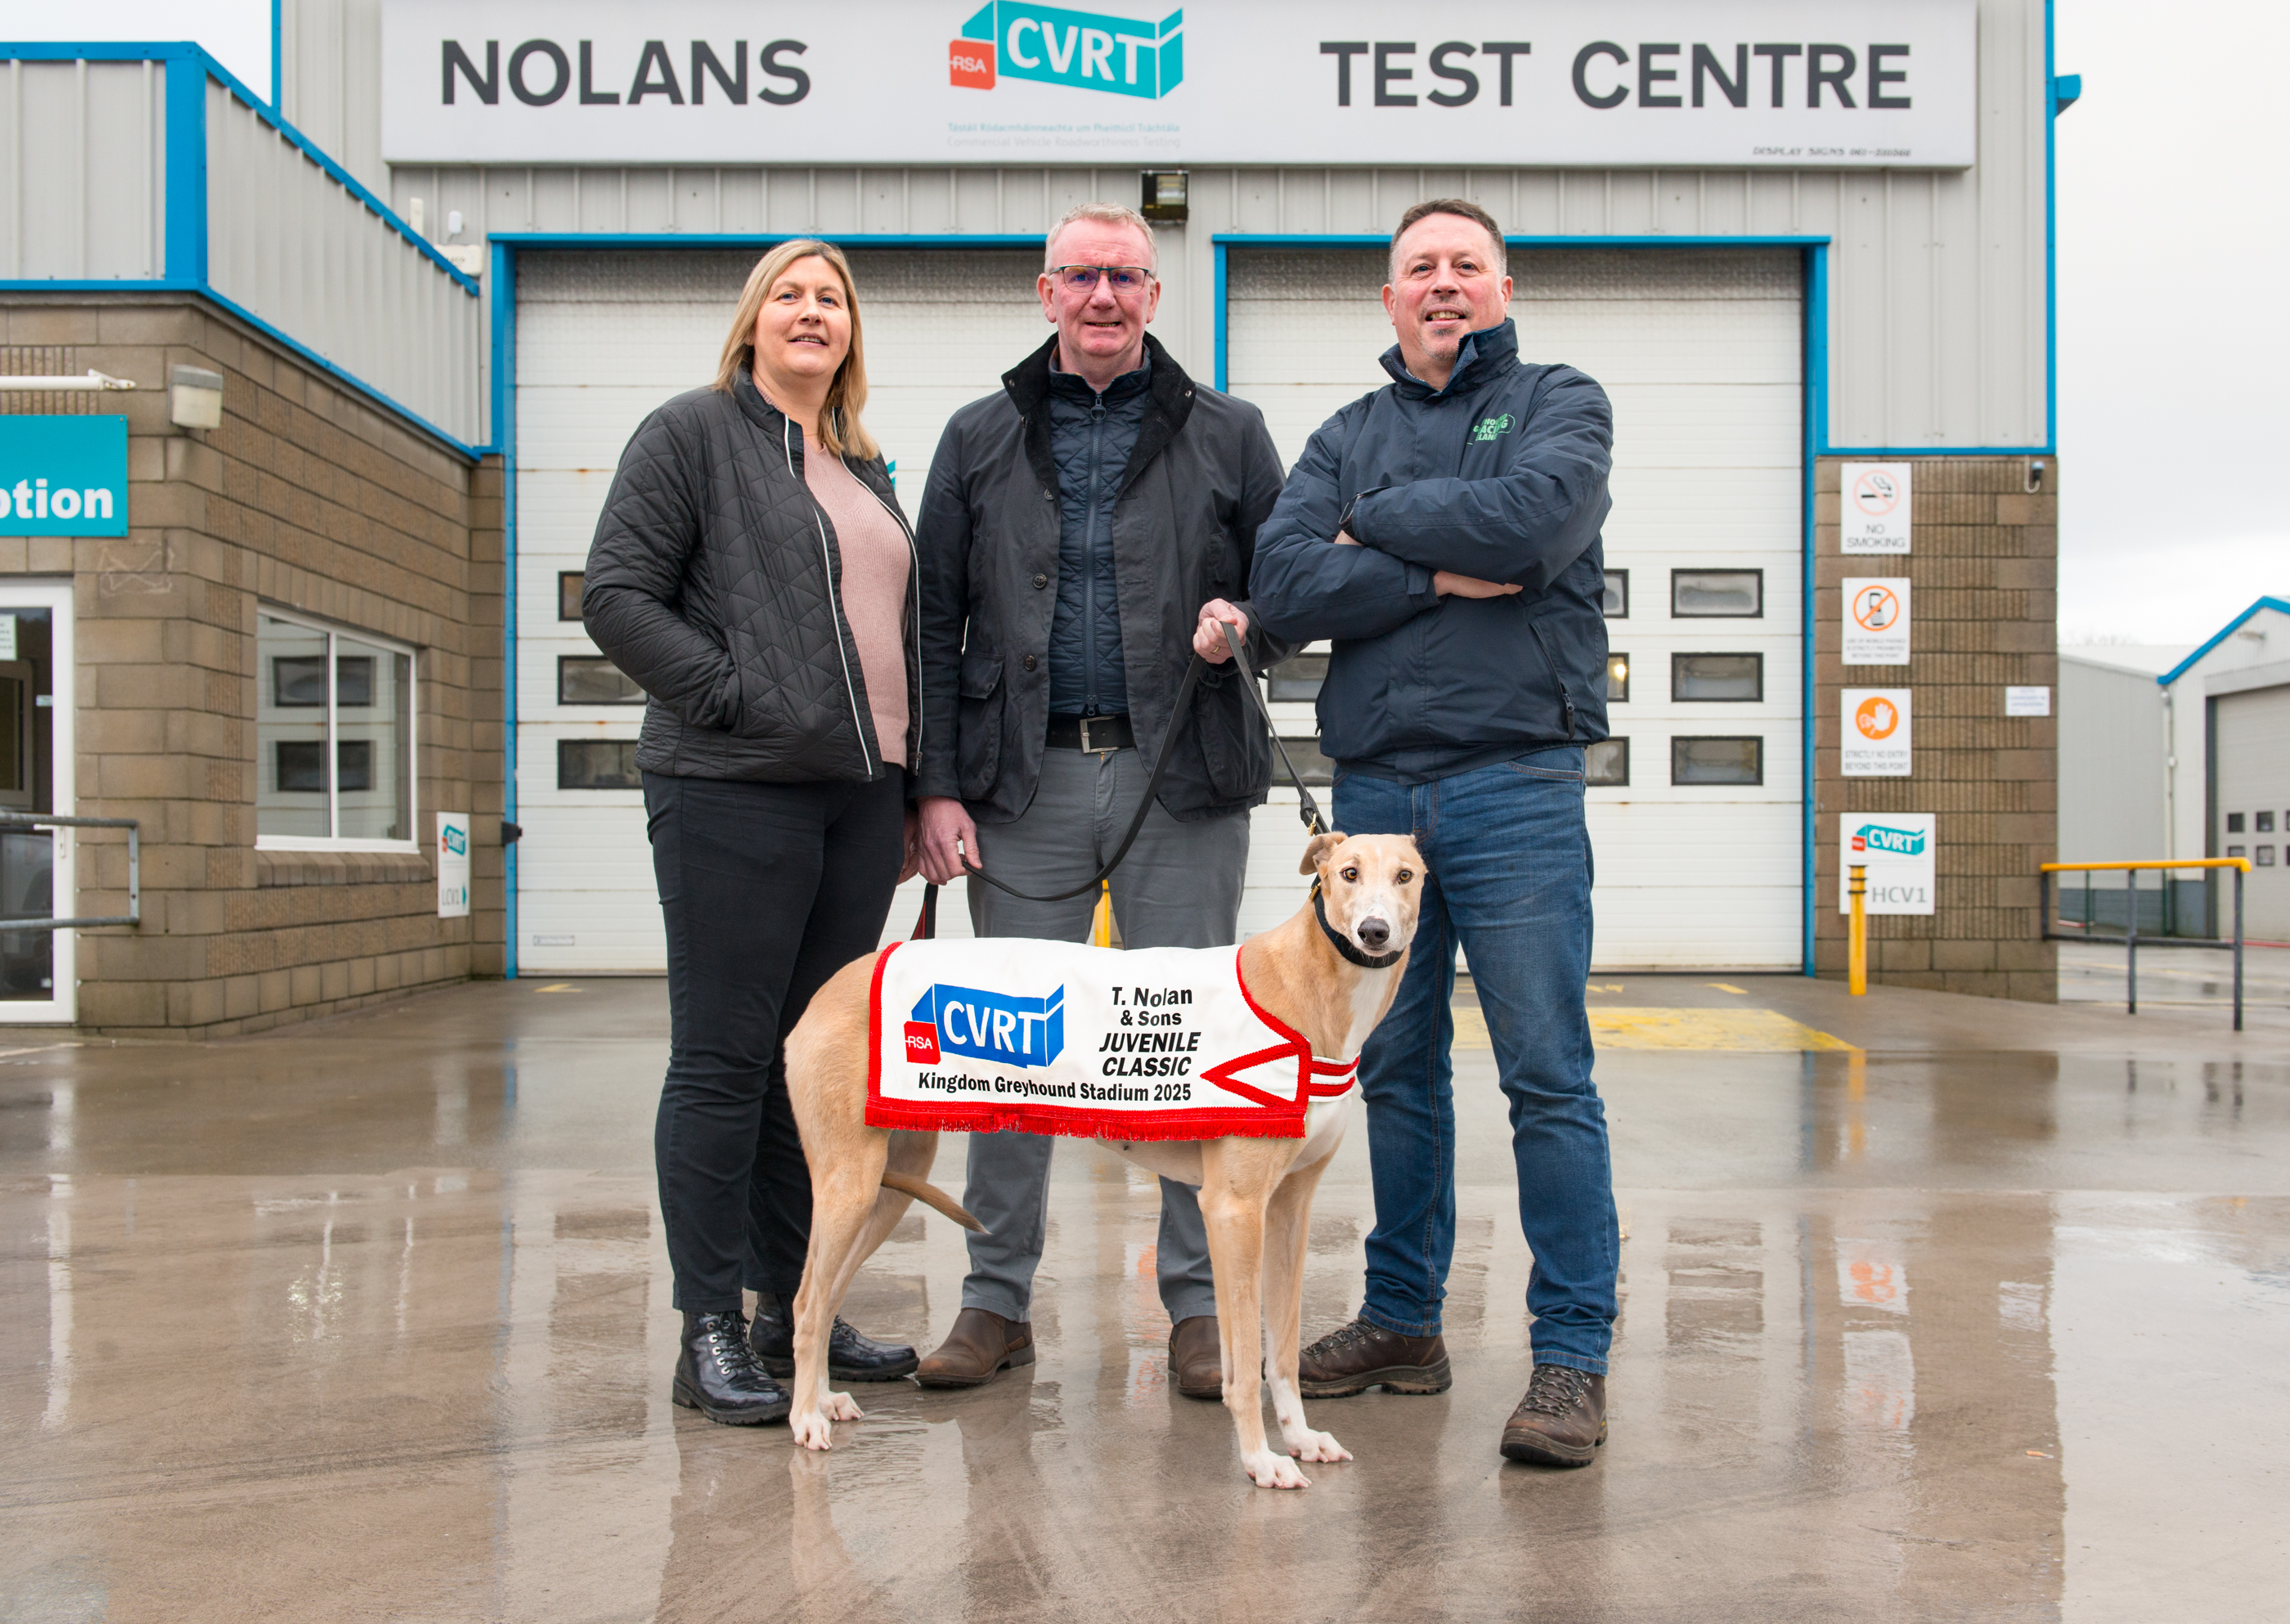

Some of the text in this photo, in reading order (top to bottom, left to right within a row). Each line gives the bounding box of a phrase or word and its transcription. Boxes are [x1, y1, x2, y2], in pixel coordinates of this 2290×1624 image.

[1007, 17, 1155, 85] CVRT
[442, 38, 810, 106] NOLANS
[951, 55, 987, 74] RSA
[1319, 41, 1912, 109] TEST CENTRE
[947, 137, 1181, 149] Commercial Vehicle Roadworthiness Testing
[1866, 523, 1885, 534] NO
[1847, 536, 1906, 548] SMOKING
[1869, 828, 1914, 852] CVRT
[1872, 886, 1927, 903] HCV1
[1112, 986, 1192, 1007] T. Nolan
[943, 1000, 1044, 1054] CVRT
[1120, 1009, 1182, 1026] & Sons
[906, 1035, 933, 1050] RSA
[1098, 1031, 1201, 1052] JUVENILE
[1102, 1056, 1192, 1077] CLASSIC
[918, 1072, 1192, 1101] Kingdom Greyhound Stadium 2025
